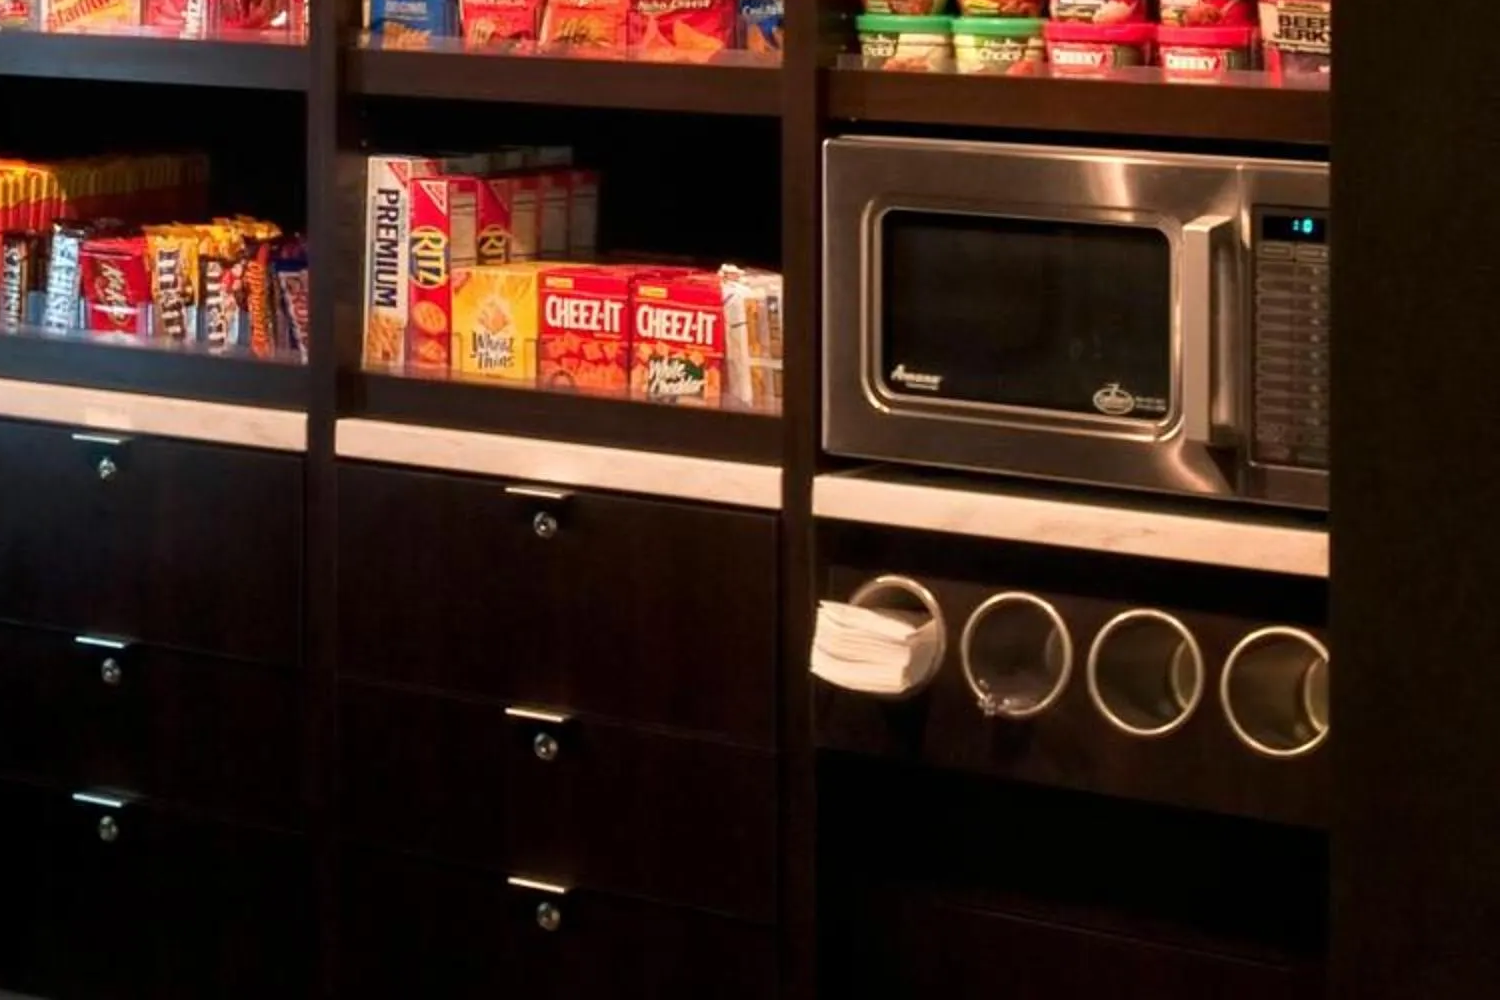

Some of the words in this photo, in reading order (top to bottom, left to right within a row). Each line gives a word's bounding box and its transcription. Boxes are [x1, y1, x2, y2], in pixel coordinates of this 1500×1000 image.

[1273, 28, 1330, 43] JERK
[375, 187, 400, 308] PREMIUM
[411, 230, 447, 286] RITZ
[545, 294, 624, 333] CHEEZ-IT
[636, 303, 718, 345] CHEEZ-IT
